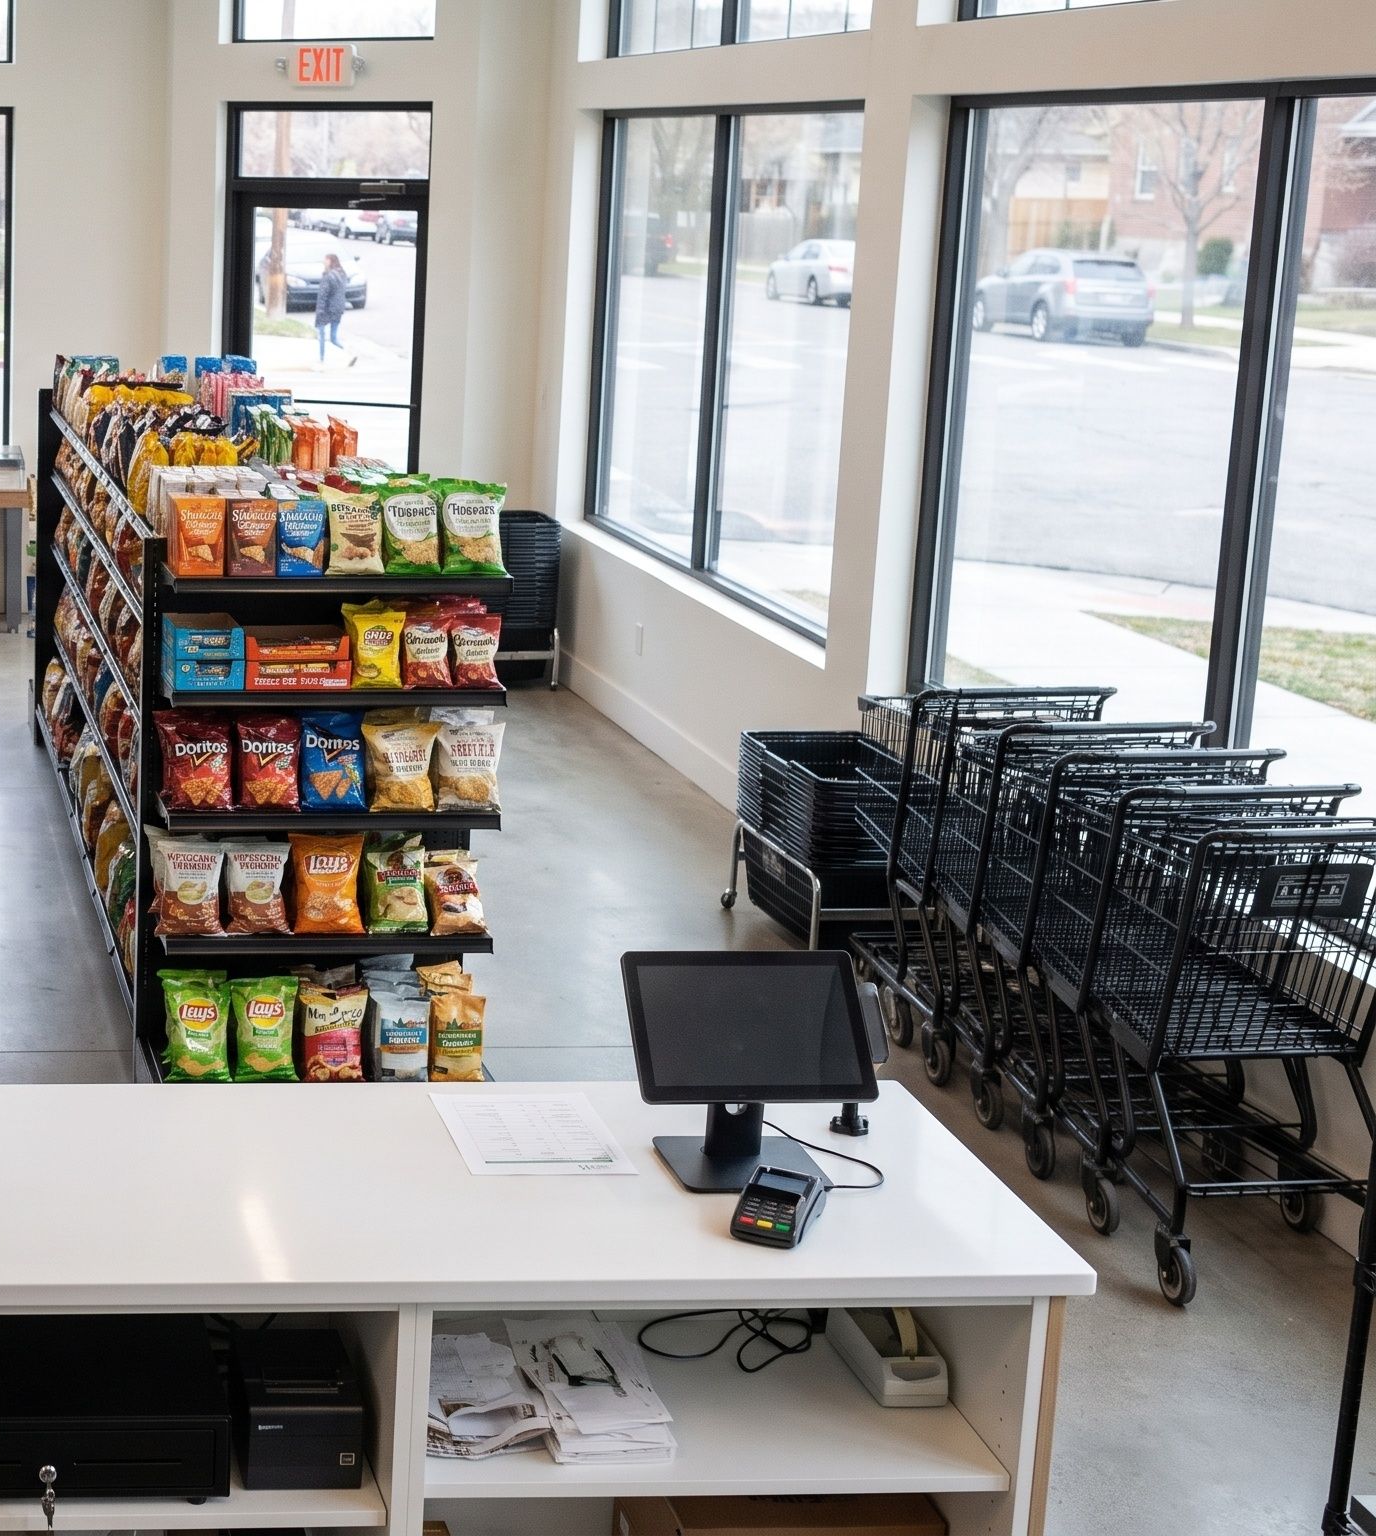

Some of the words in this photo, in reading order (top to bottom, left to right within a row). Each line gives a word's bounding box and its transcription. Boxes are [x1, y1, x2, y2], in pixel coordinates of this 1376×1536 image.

[299, 48, 344, 81] EXIT
[175, 740, 228, 757] Doritos
[248, 1000, 282, 1018] Lays
